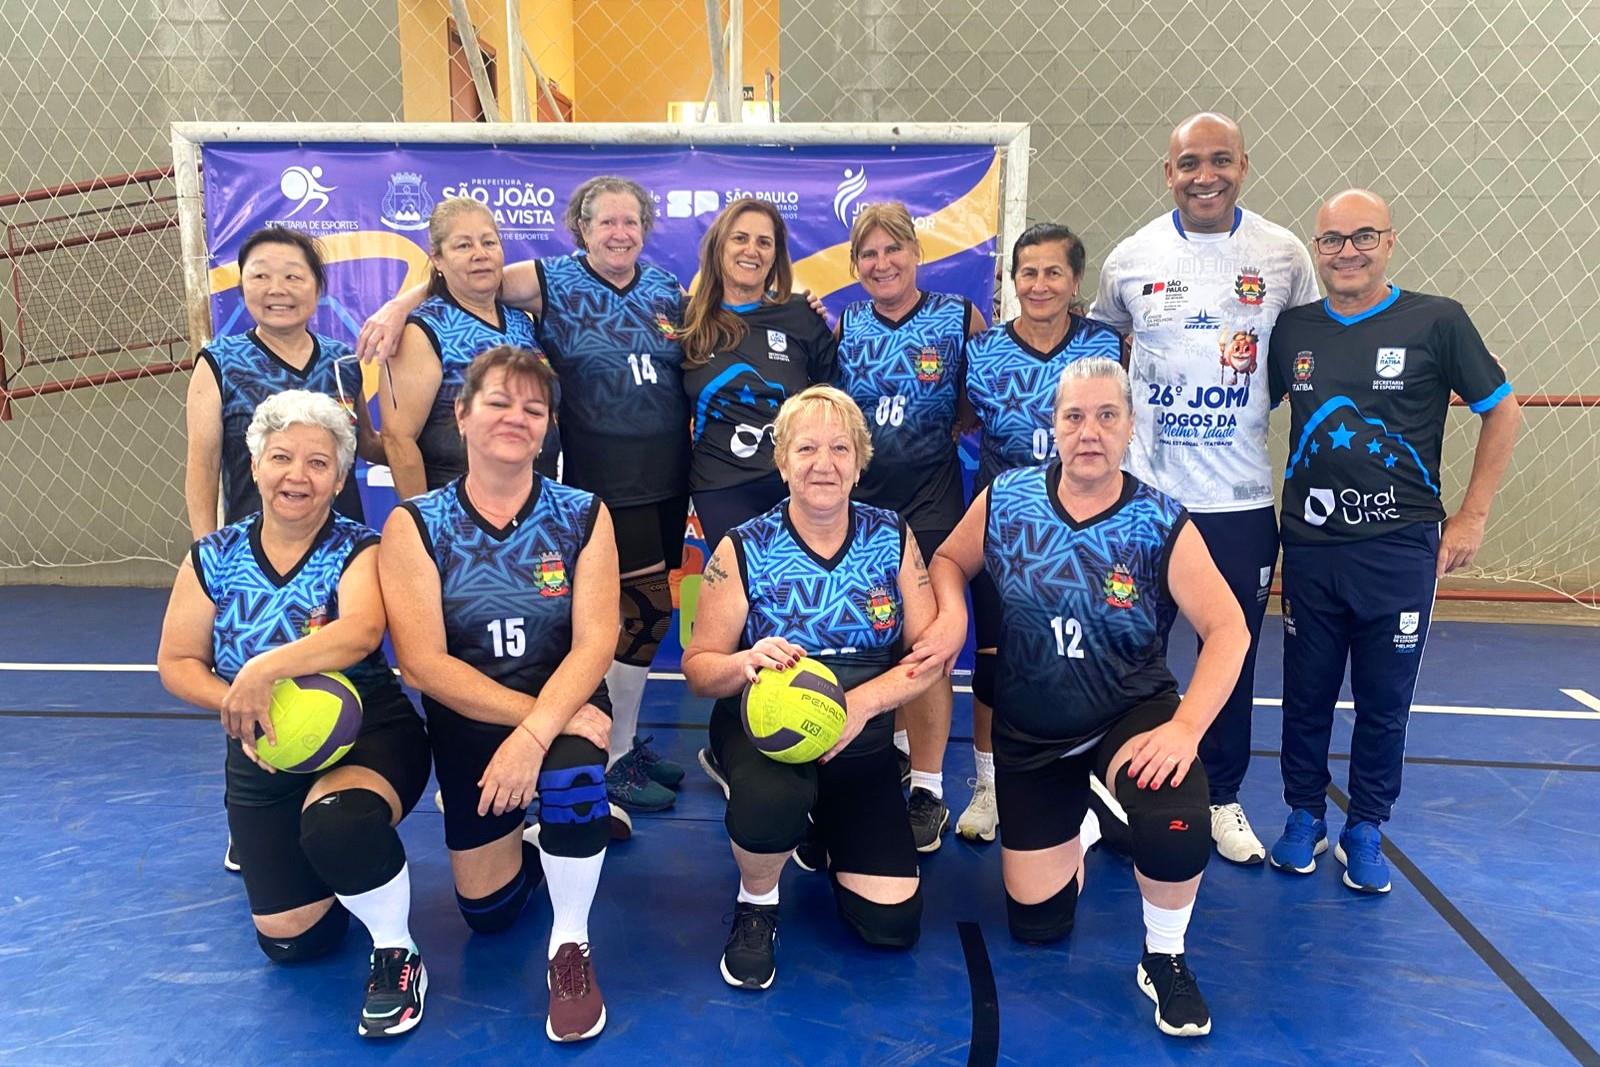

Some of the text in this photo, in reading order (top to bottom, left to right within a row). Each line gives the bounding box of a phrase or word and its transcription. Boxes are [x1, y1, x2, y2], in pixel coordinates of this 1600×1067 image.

[493, 183, 555, 207] JOÃO
[756, 191, 799, 202] PAULO
[309, 221, 320, 229] DE
[321, 221, 358, 230] ESPORTES
[494, 209, 555, 225] A VISTA
[514, 233, 549, 241] ESPORTES
[1167, 280, 1182, 288] SÃO
[627, 353, 658, 386] 14
[1187, 386, 1250, 409] JOMI
[875, 395, 906, 426] 06
[1157, 412, 1237, 427] JOGOS DA
[1159, 423, 1200, 438] Melhor
[1340, 485, 1396, 507] Oral
[1342, 506, 1400, 525] Unic
[487, 617, 526, 658] 15
[1050, 616, 1085, 659] 12
